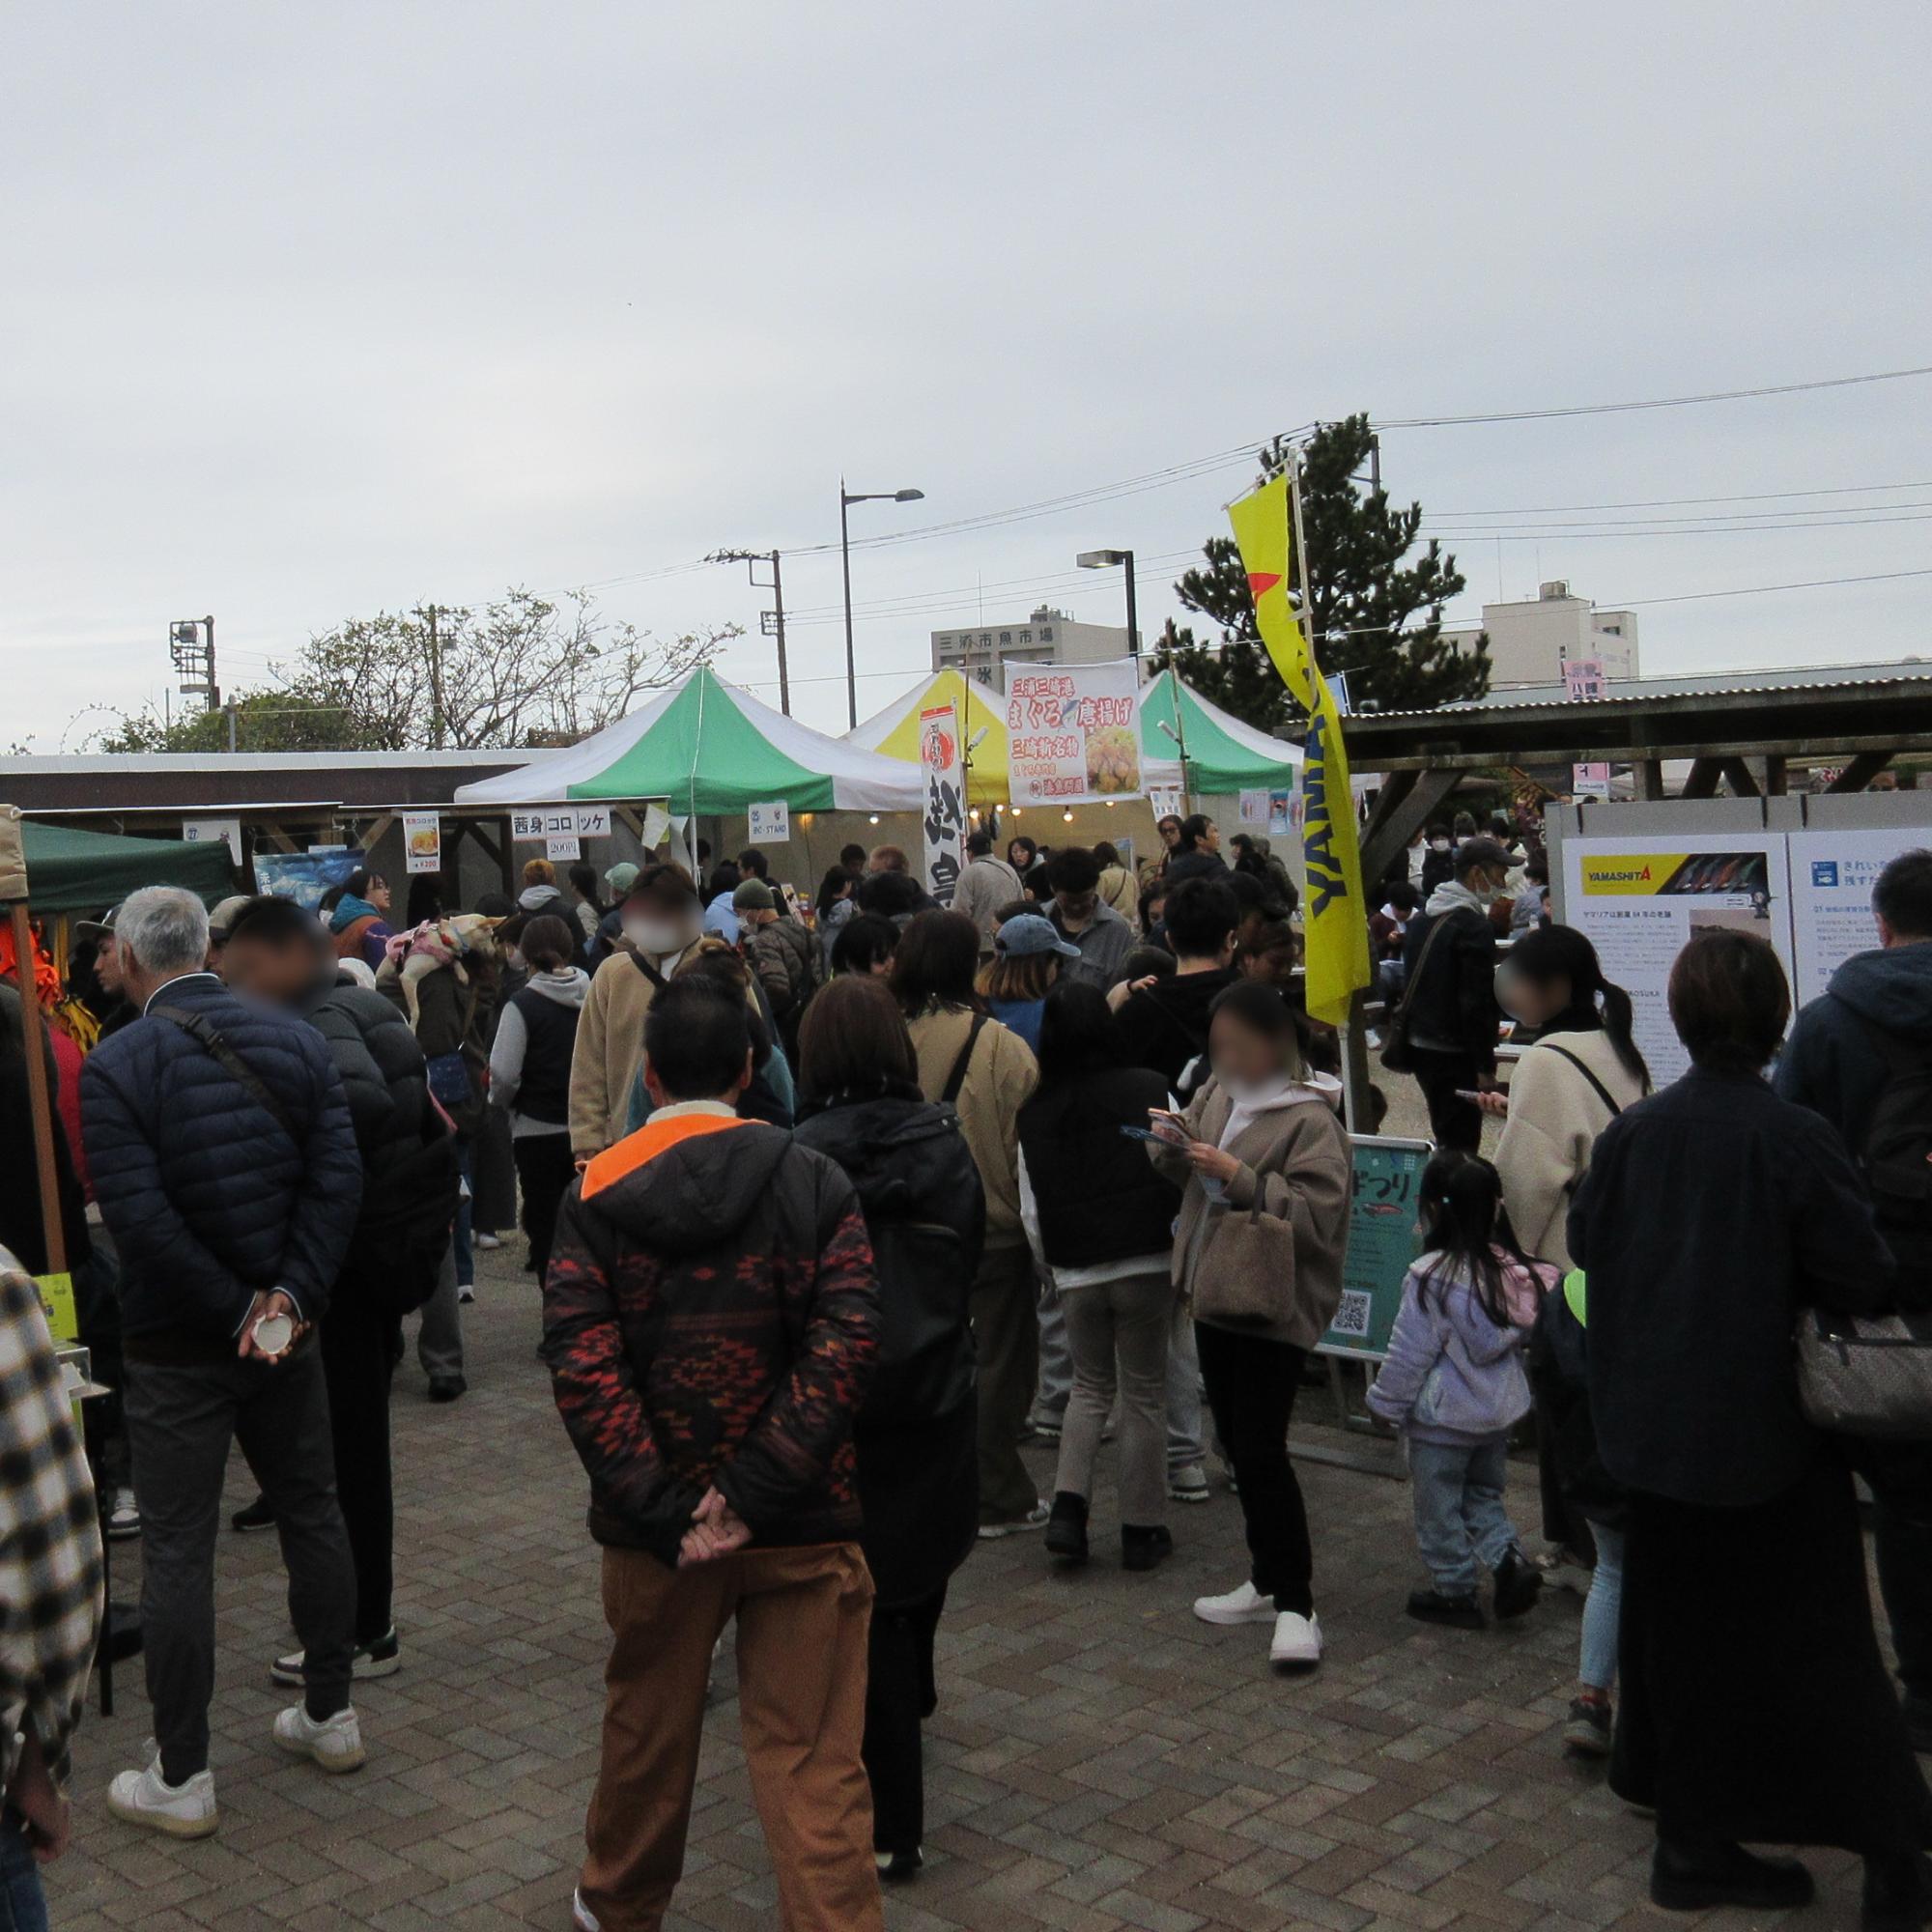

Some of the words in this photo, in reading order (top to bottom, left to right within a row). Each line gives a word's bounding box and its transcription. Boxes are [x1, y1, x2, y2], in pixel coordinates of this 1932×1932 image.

[939, 626, 1053, 650] 三浦市魚市場
[1011, 676, 1075, 696] 三浦三崎港
[1009, 698, 1062, 729] まぐろ
[1077, 696, 1133, 727] 唐揚げ
[1012, 735, 1079, 759] 三崎新名物
[514, 813, 604, 834] 茜身コロッケ
[550, 841, 577, 854] 200円
[1588, 865, 1651, 881] YAMASHITA
